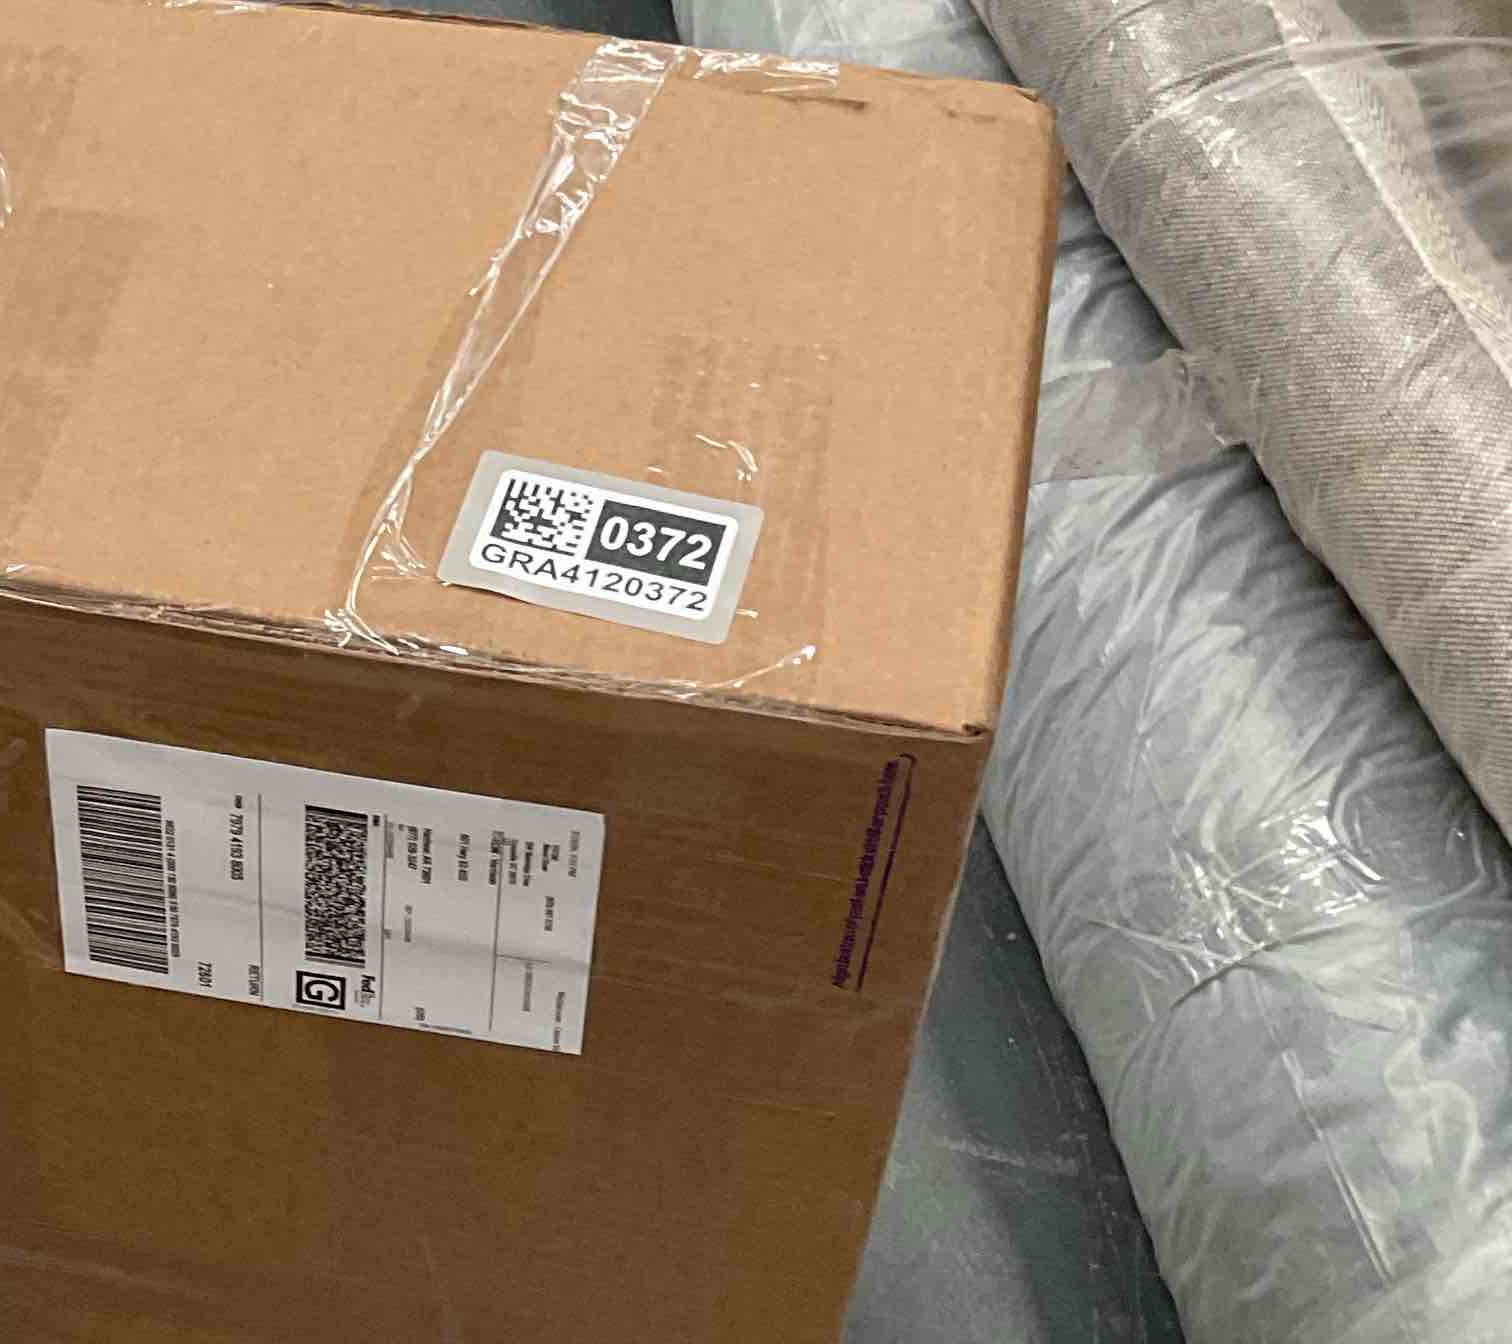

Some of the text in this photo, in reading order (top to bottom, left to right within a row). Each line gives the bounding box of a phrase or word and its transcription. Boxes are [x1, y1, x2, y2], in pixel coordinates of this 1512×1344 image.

[599, 516, 713, 570] 0372
[481, 543, 708, 612] GRA4120372
[197, 960, 212, 988] 72601
[247, 964, 260, 996] RETURN
[304, 977, 340, 1003] G
